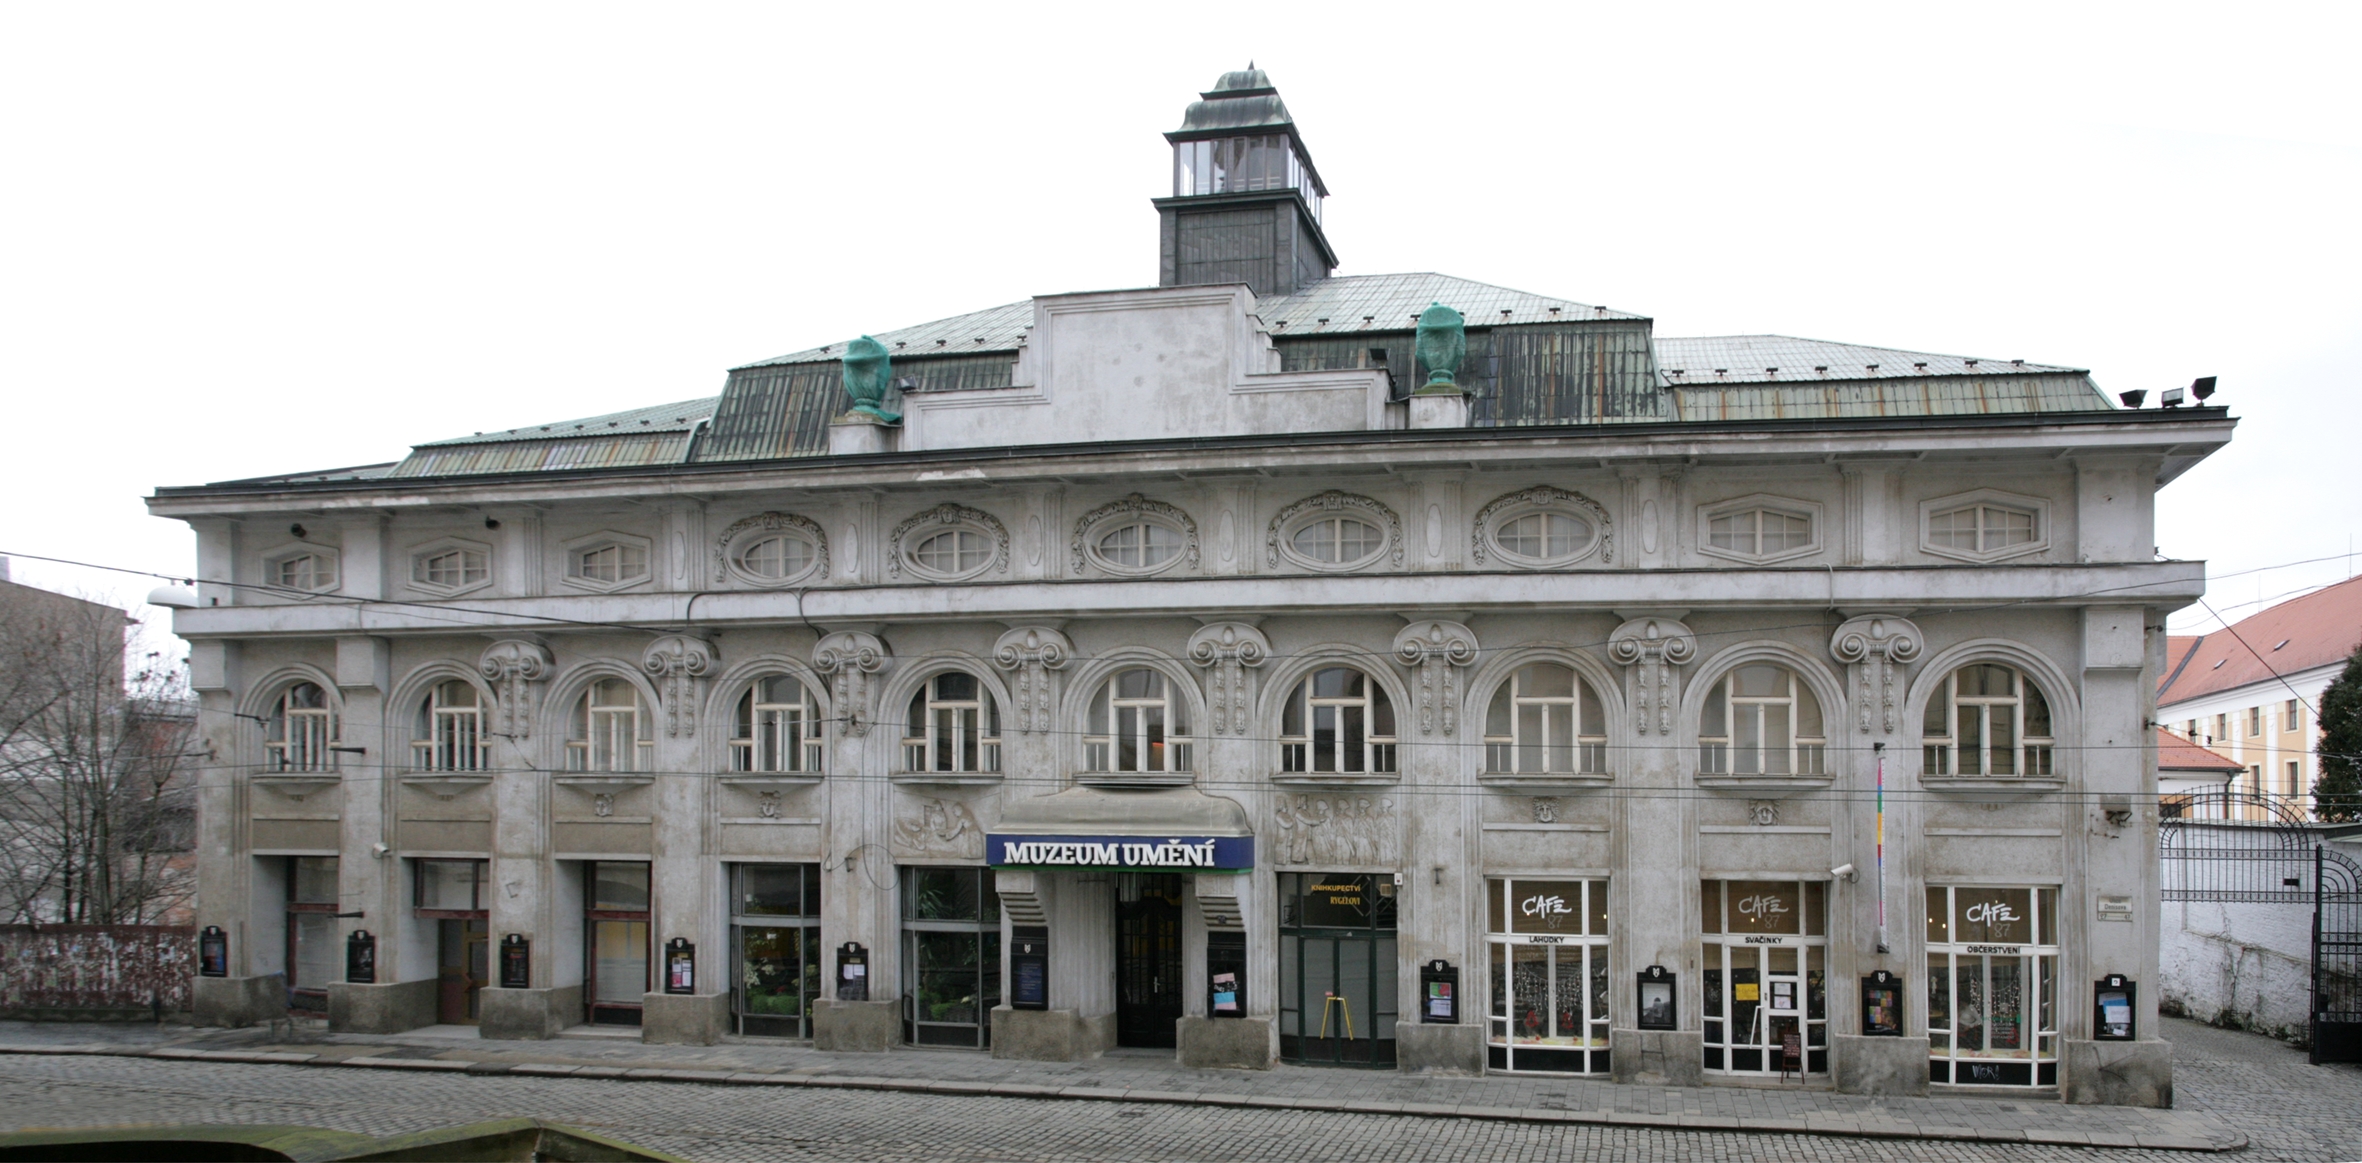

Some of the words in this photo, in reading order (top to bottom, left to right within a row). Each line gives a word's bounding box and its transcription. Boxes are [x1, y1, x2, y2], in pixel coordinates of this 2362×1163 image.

[1003, 841, 1120, 866] MUZEUM
[1121, 838, 1216, 866] UMĚNÍ
[1311, 883, 1361, 892] KNIHKUPECTVÍ
[1547, 914, 1563, 929] 87
[1764, 914, 1780, 929] 87
[1994, 923, 2011, 938] 87
[1745, 935, 1783, 944] SVAČINKY
